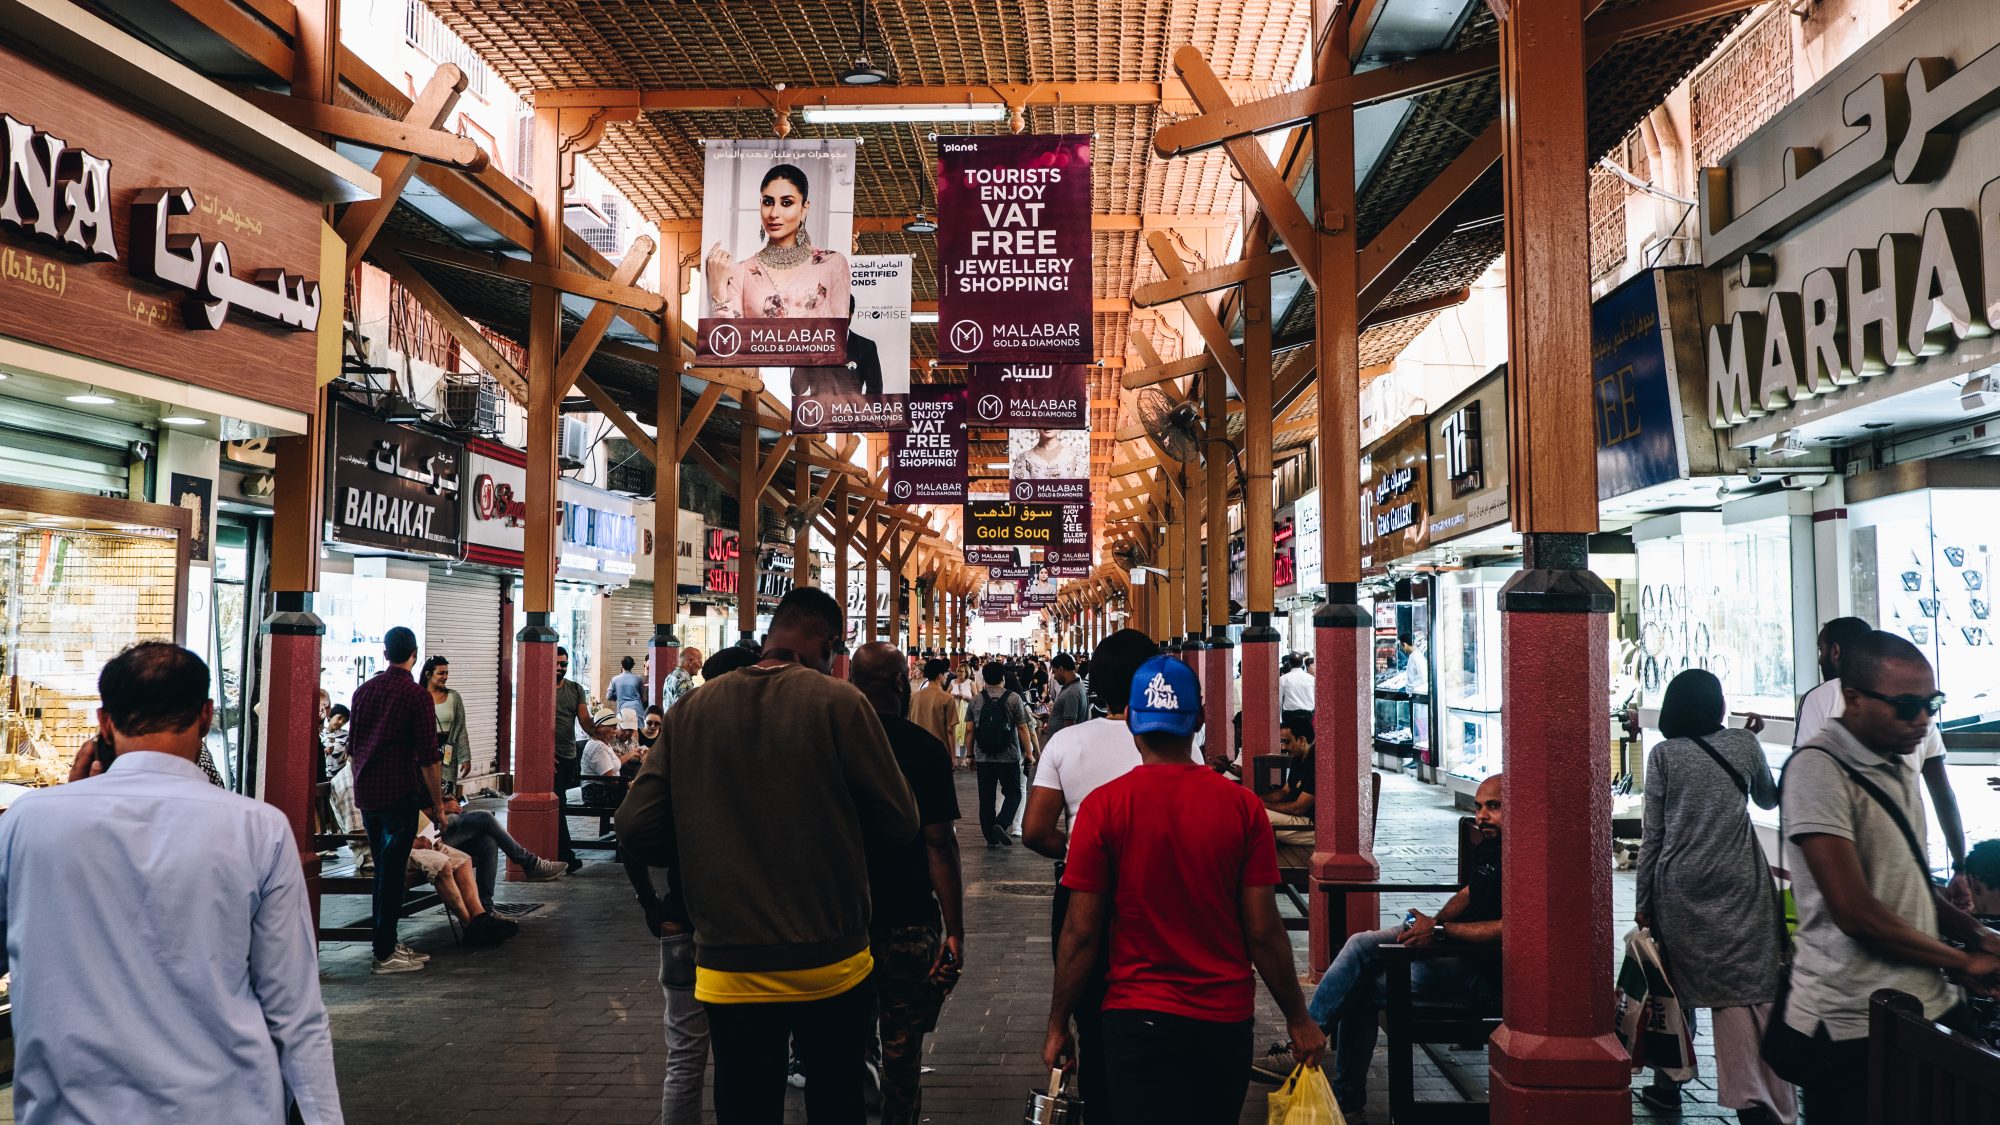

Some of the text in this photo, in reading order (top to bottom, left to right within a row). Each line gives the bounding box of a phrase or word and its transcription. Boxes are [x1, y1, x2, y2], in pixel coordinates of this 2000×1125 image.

[793, 149, 806, 160] من
[943, 144, 978, 152] planet
[965, 168, 1062, 184] TOURISTS
[980, 185, 1046, 201] ENJOY
[201, 195, 263, 235] مجوهرات
[982, 202, 1046, 228] VAT
[971, 229, 1058, 255] FREE
[954, 258, 1074, 275] JEWELLERY
[851, 270, 899, 278] CERTIFIED
[959, 276, 1069, 292] SHOPPING!
[750, 329, 836, 343] MALABAR
[993, 323, 1080, 338] MALABAR
[750, 344, 836, 352] GOLD & DIAMONDS
[993, 338, 1080, 348] GOLD & DIAMONDS
[832, 402, 903, 413] MALABAR
[1010, 399, 1077, 410] MALABAR
[861, 414, 903, 422] DIAMONDS
[911, 410, 946, 419] ENJOY
[912, 420, 945, 434] VAT
[906, 434, 951, 448] FREE
[897, 449, 959, 458] JEWELLERY
[899, 458, 957, 467] SHOPPING!
[375, 440, 460, 502] بركات
[1037, 484, 1083, 492] MALABAR
[344, 487, 436, 539] BARAKAT
[973, 504, 1054, 521] سوق الذهب
[976, 525, 1050, 541] Gold Souq
[1144, 688, 1179, 710] Dhabi
